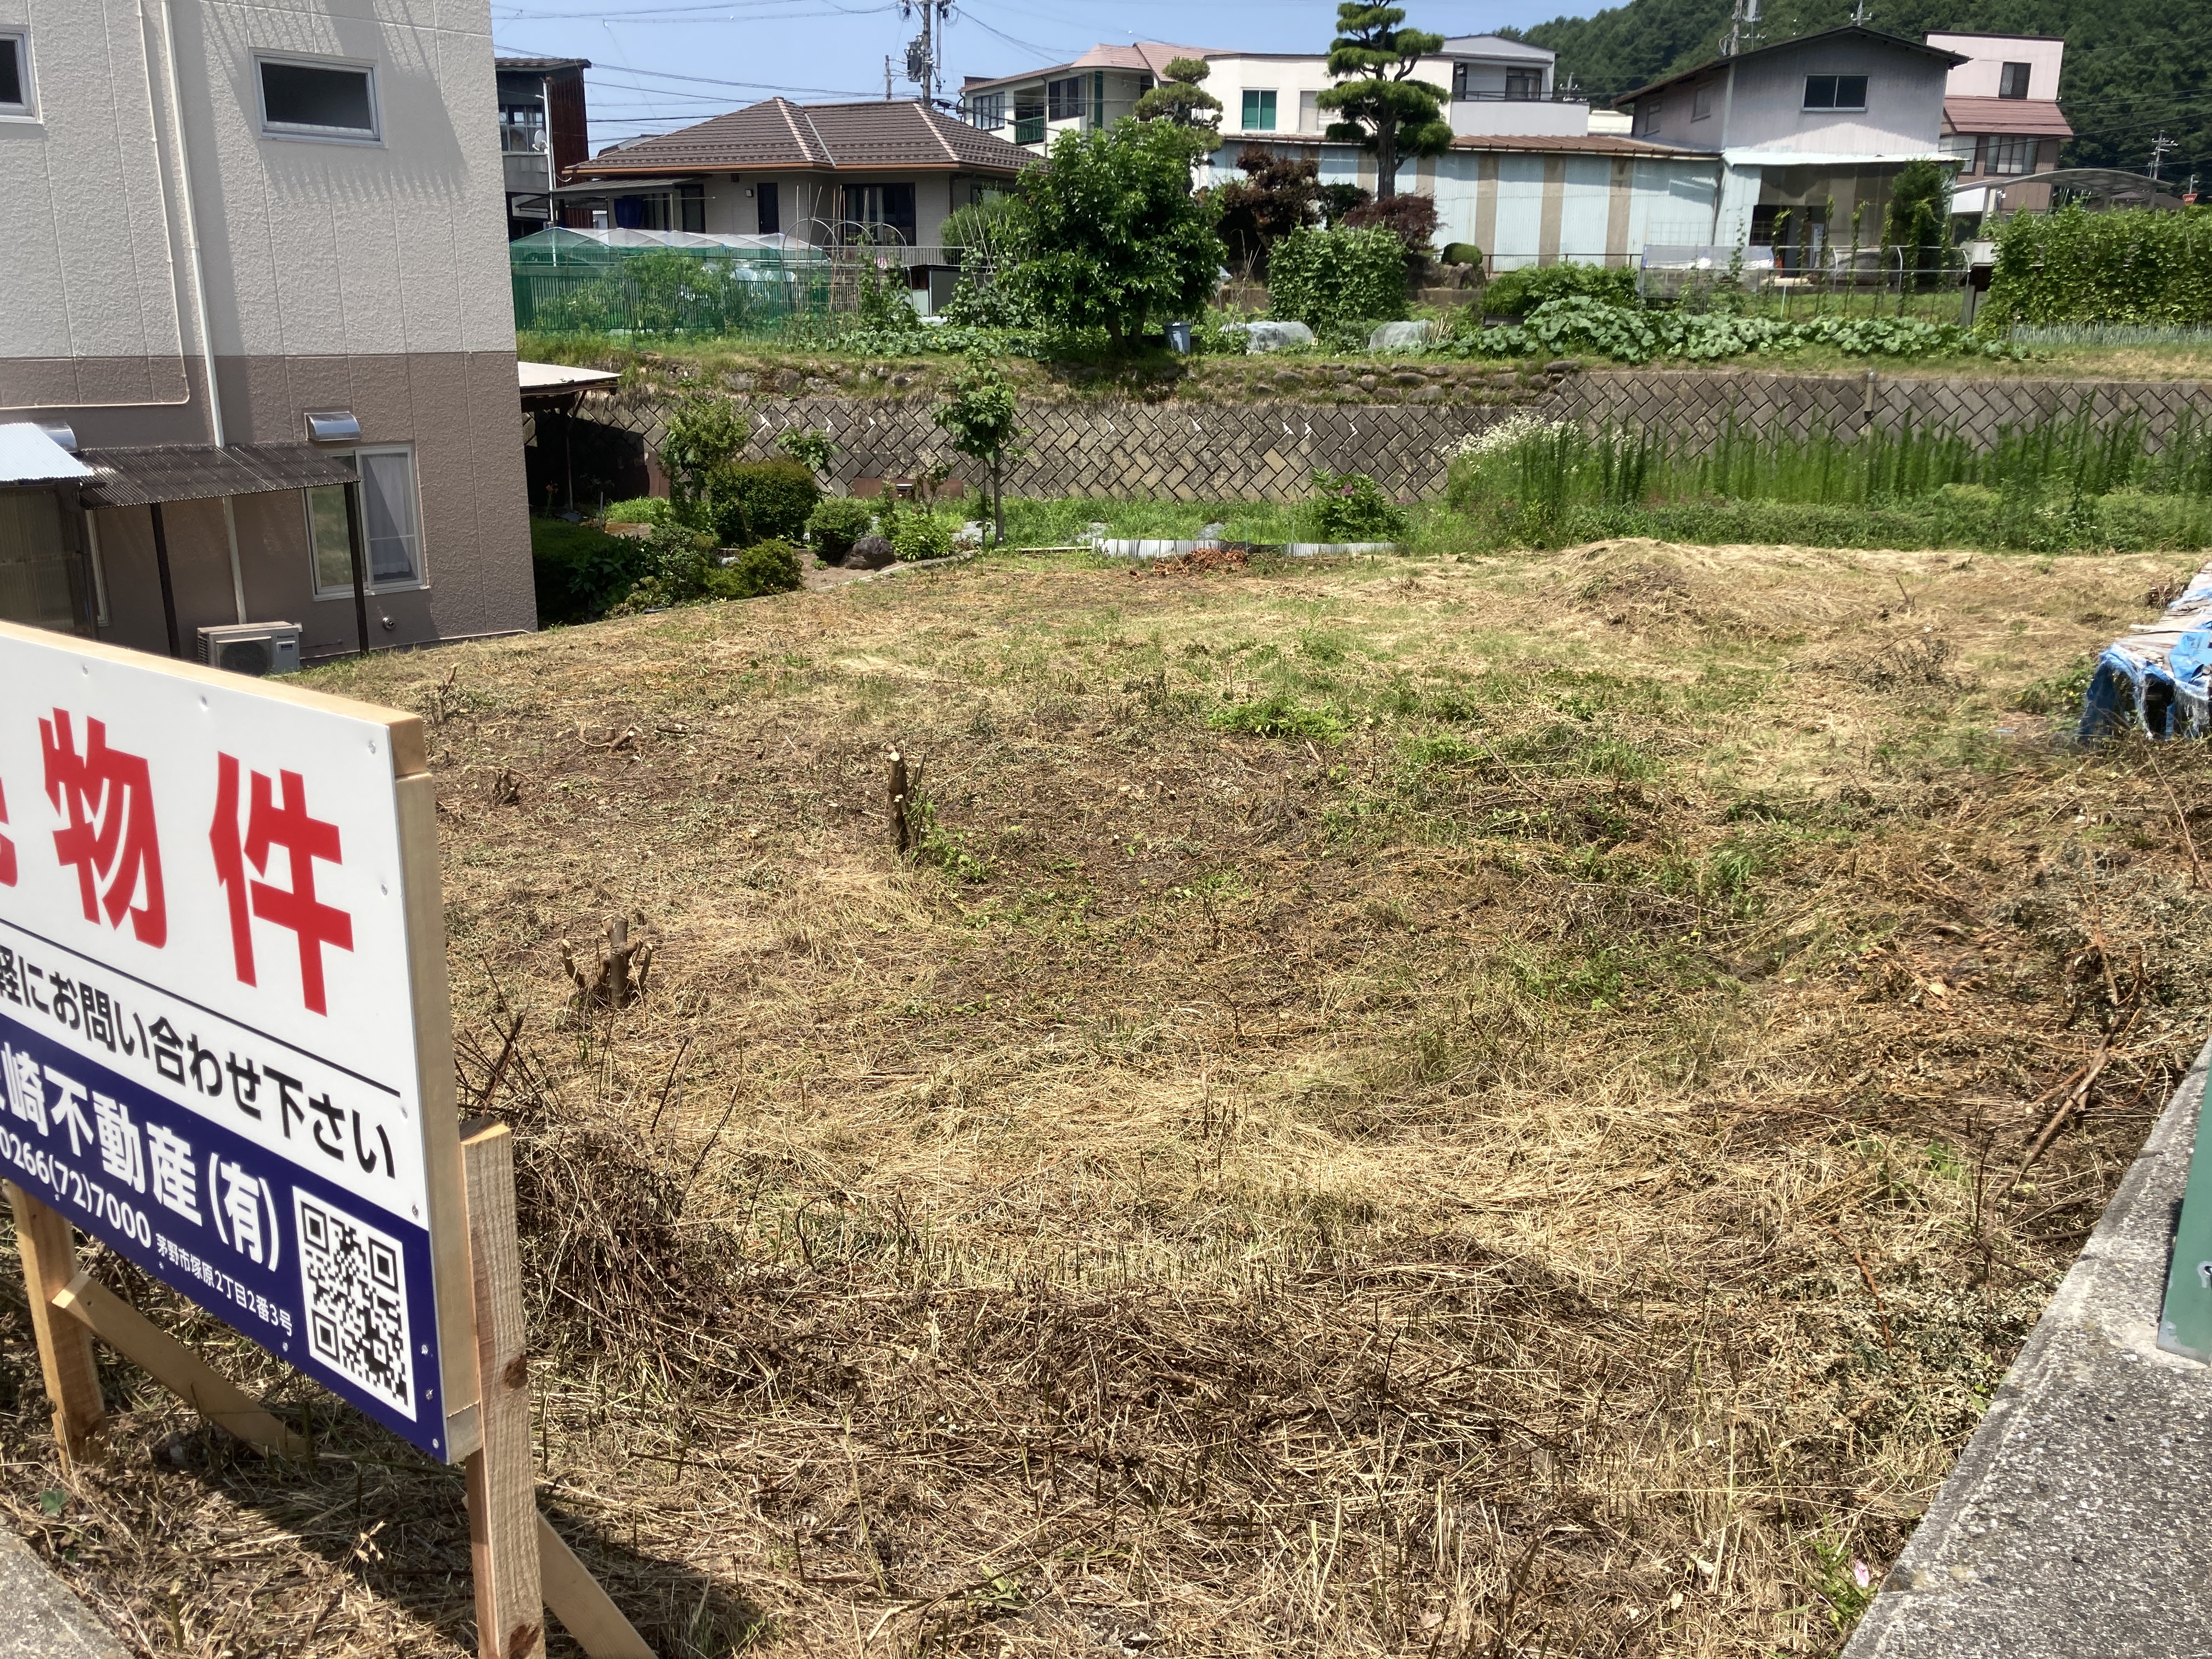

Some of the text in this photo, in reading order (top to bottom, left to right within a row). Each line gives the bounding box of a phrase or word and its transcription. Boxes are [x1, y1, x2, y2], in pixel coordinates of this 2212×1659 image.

[0, 707, 354, 1018] 物件
[0, 1041, 280, 1272] 崎不動産(有)
[0, 1126, 292, 1337] 0266(72)7000 茅野市塚原2丁目2番3号
